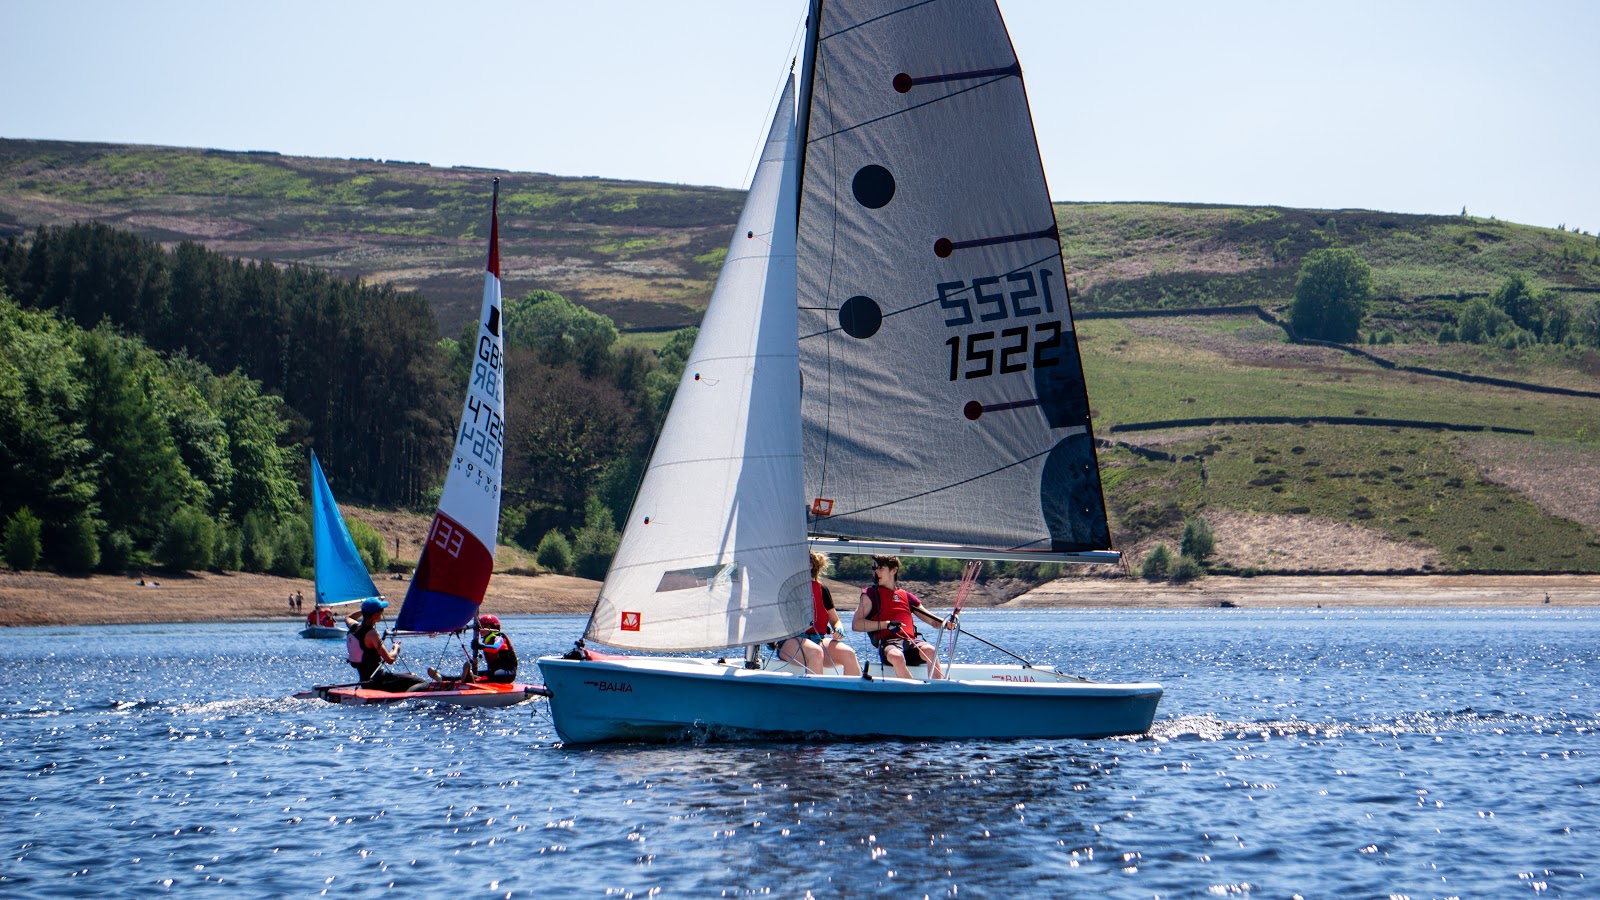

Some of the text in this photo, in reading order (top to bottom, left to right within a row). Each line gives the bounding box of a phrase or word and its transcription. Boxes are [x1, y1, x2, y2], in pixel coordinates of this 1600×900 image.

[946, 320, 1061, 381] 1522
[457, 457, 498, 492] VOLVO
[599, 681, 633, 692] BAHIA
